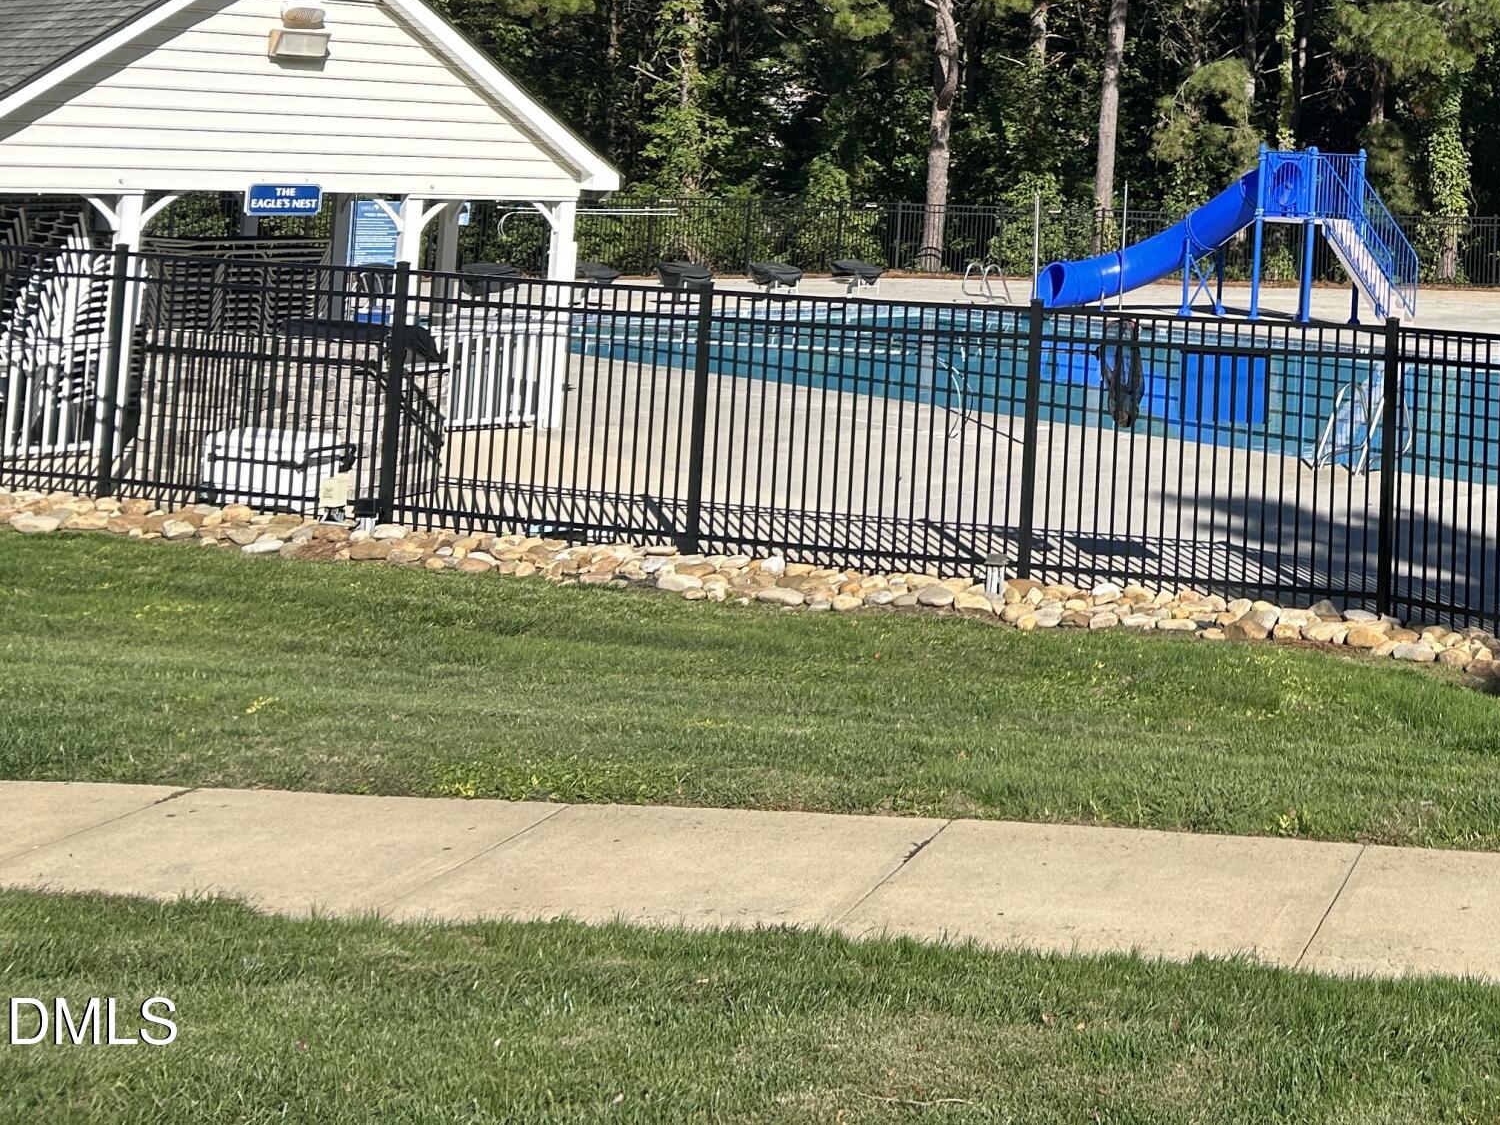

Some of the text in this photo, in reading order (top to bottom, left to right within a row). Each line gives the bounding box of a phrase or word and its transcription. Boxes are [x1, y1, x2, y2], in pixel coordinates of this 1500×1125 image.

[275, 187, 296, 196] THE
[250, 198, 317, 208] EAGLE'S NEST
